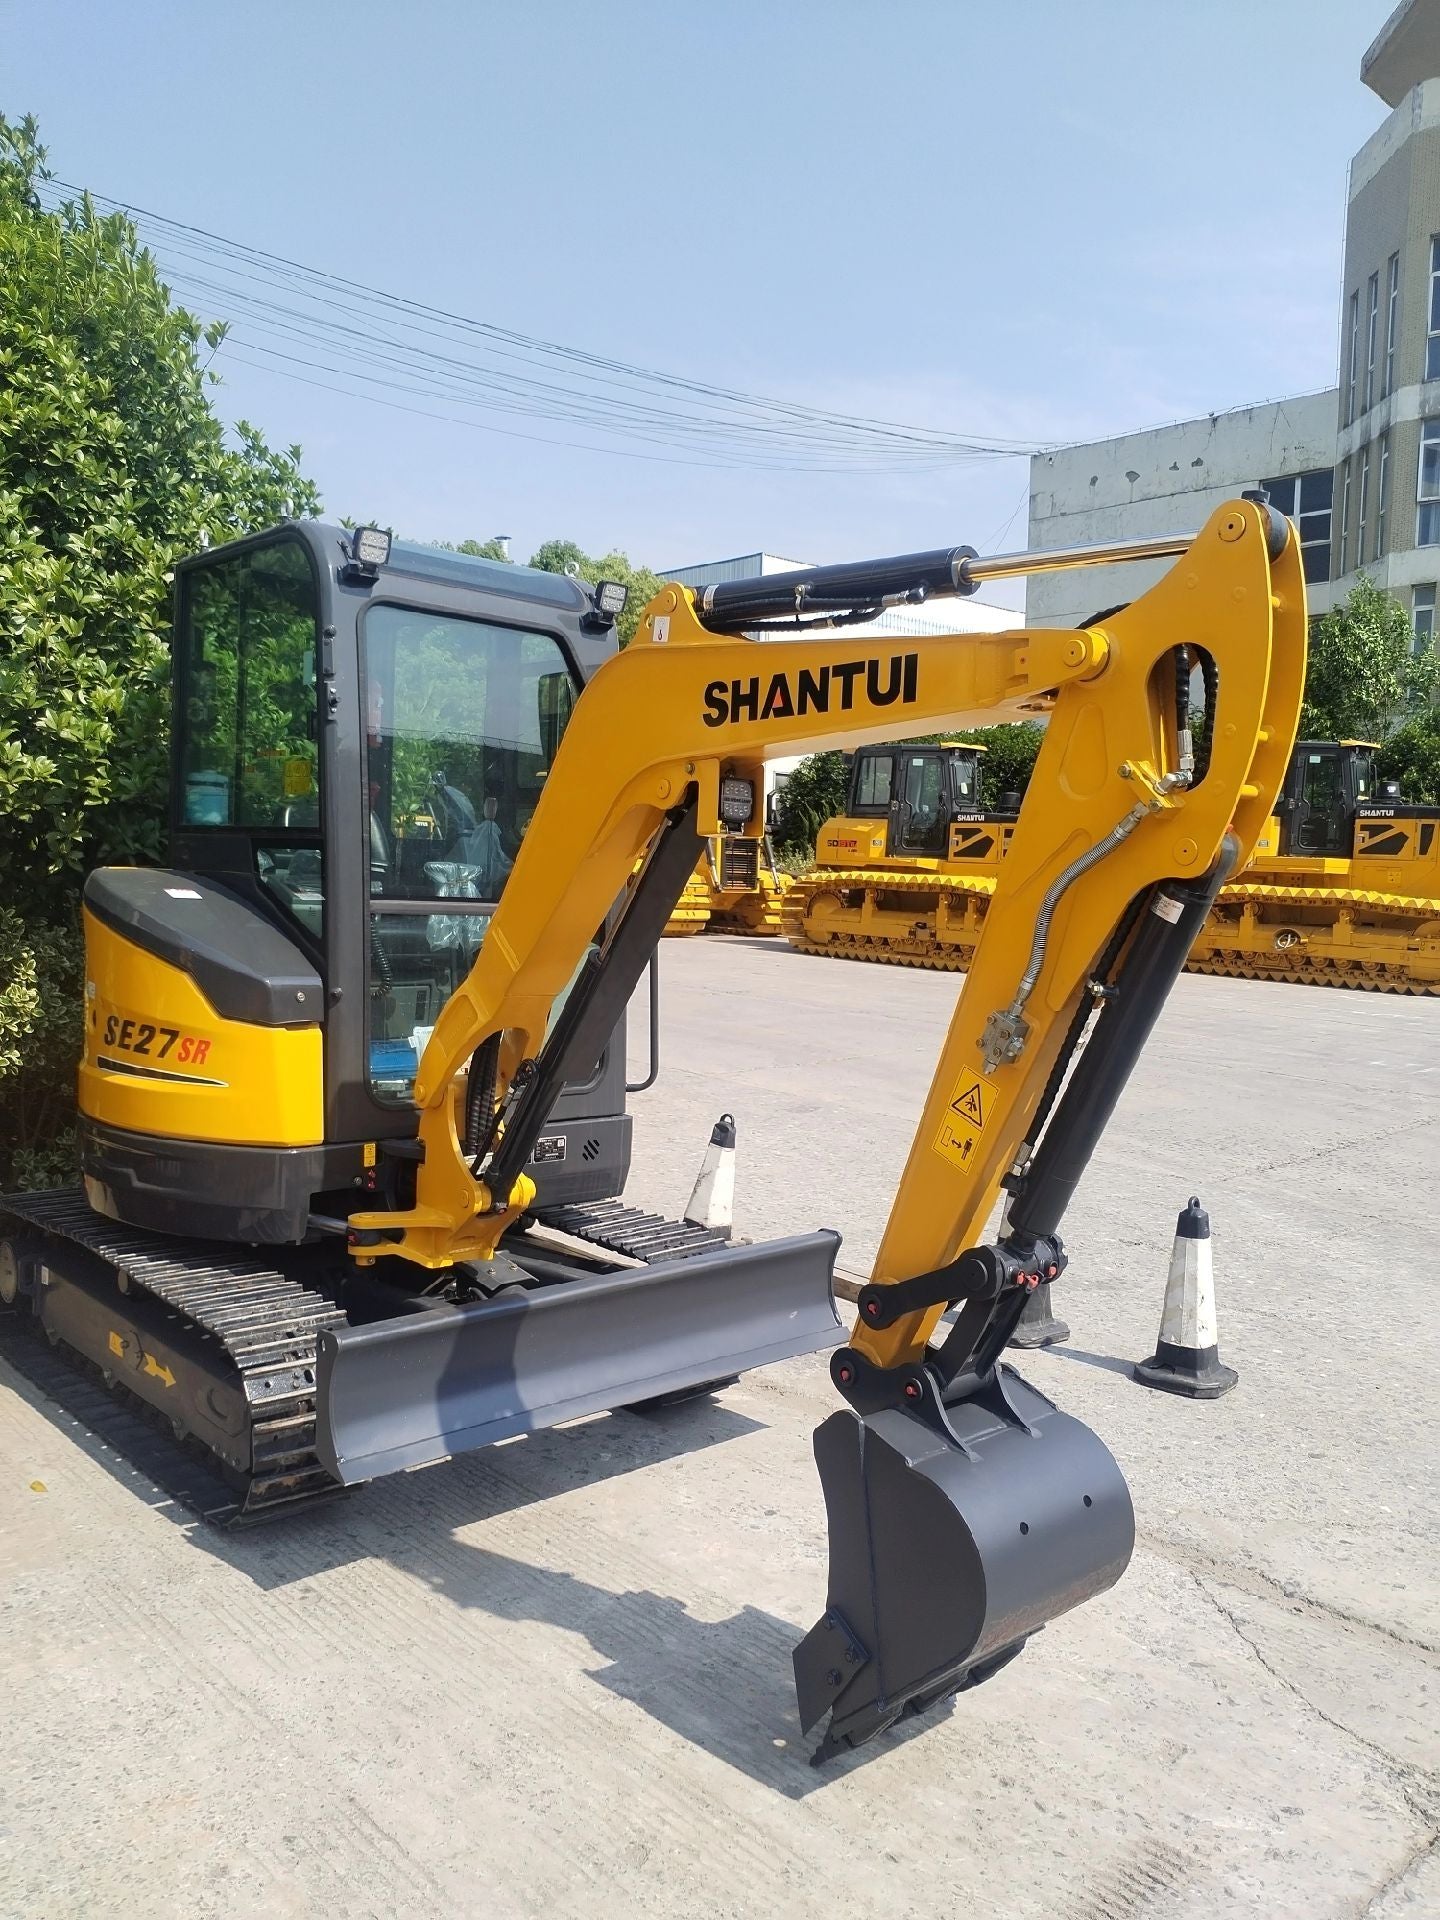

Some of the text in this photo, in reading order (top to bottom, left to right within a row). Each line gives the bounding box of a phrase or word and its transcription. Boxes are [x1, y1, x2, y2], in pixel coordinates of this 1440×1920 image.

[702, 653, 918, 727] SHANTUI
[1359, 809, 1394, 817] SHANTUI
[957, 814, 985, 822] SHANTUI
